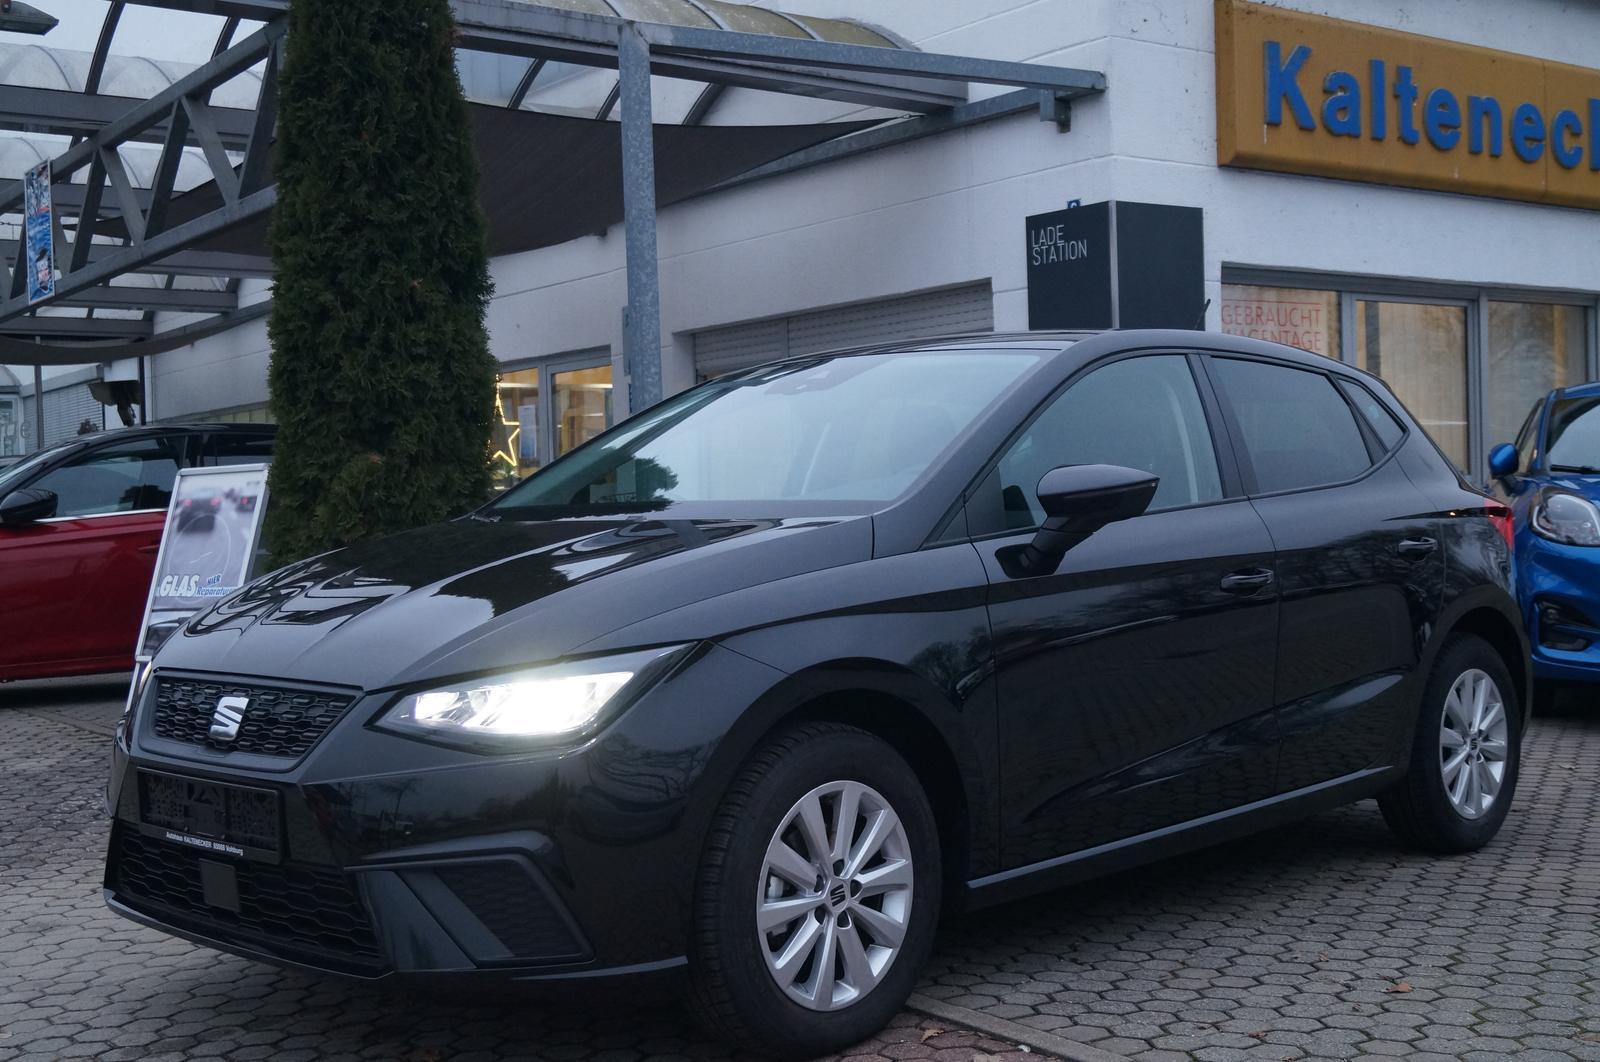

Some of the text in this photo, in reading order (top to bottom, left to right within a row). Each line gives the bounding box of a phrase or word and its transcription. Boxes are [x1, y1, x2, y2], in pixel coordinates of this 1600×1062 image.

[1031, 224, 1065, 248] LADE
[1032, 239, 1087, 266] STATION
[1221, 304, 1322, 329] GEBRAUCHT
[1221, 328, 1322, 351] ENTAGE
[159, 574, 200, 597] GLAS
